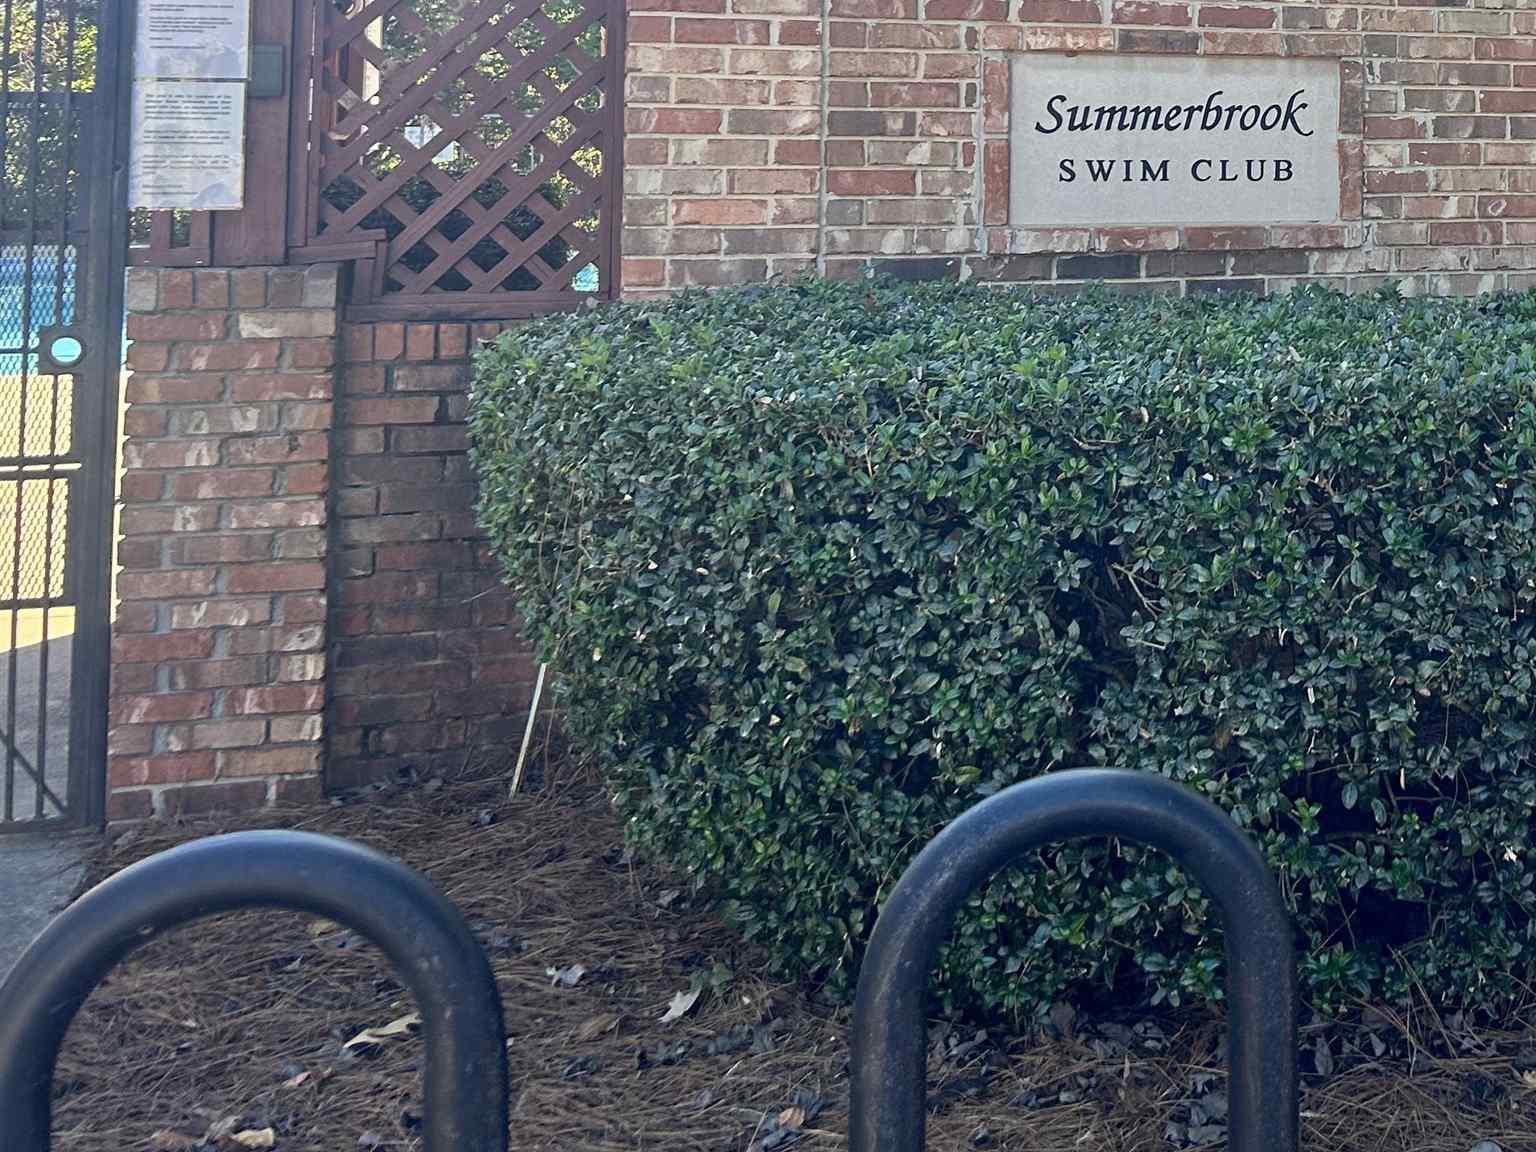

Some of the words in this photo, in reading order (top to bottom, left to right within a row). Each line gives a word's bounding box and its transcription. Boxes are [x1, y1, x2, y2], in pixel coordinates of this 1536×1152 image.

[1034, 89, 1314, 136] Summerbrook
[1058, 159, 1170, 183] SWIM
[1191, 159, 1294, 182] CLUB
